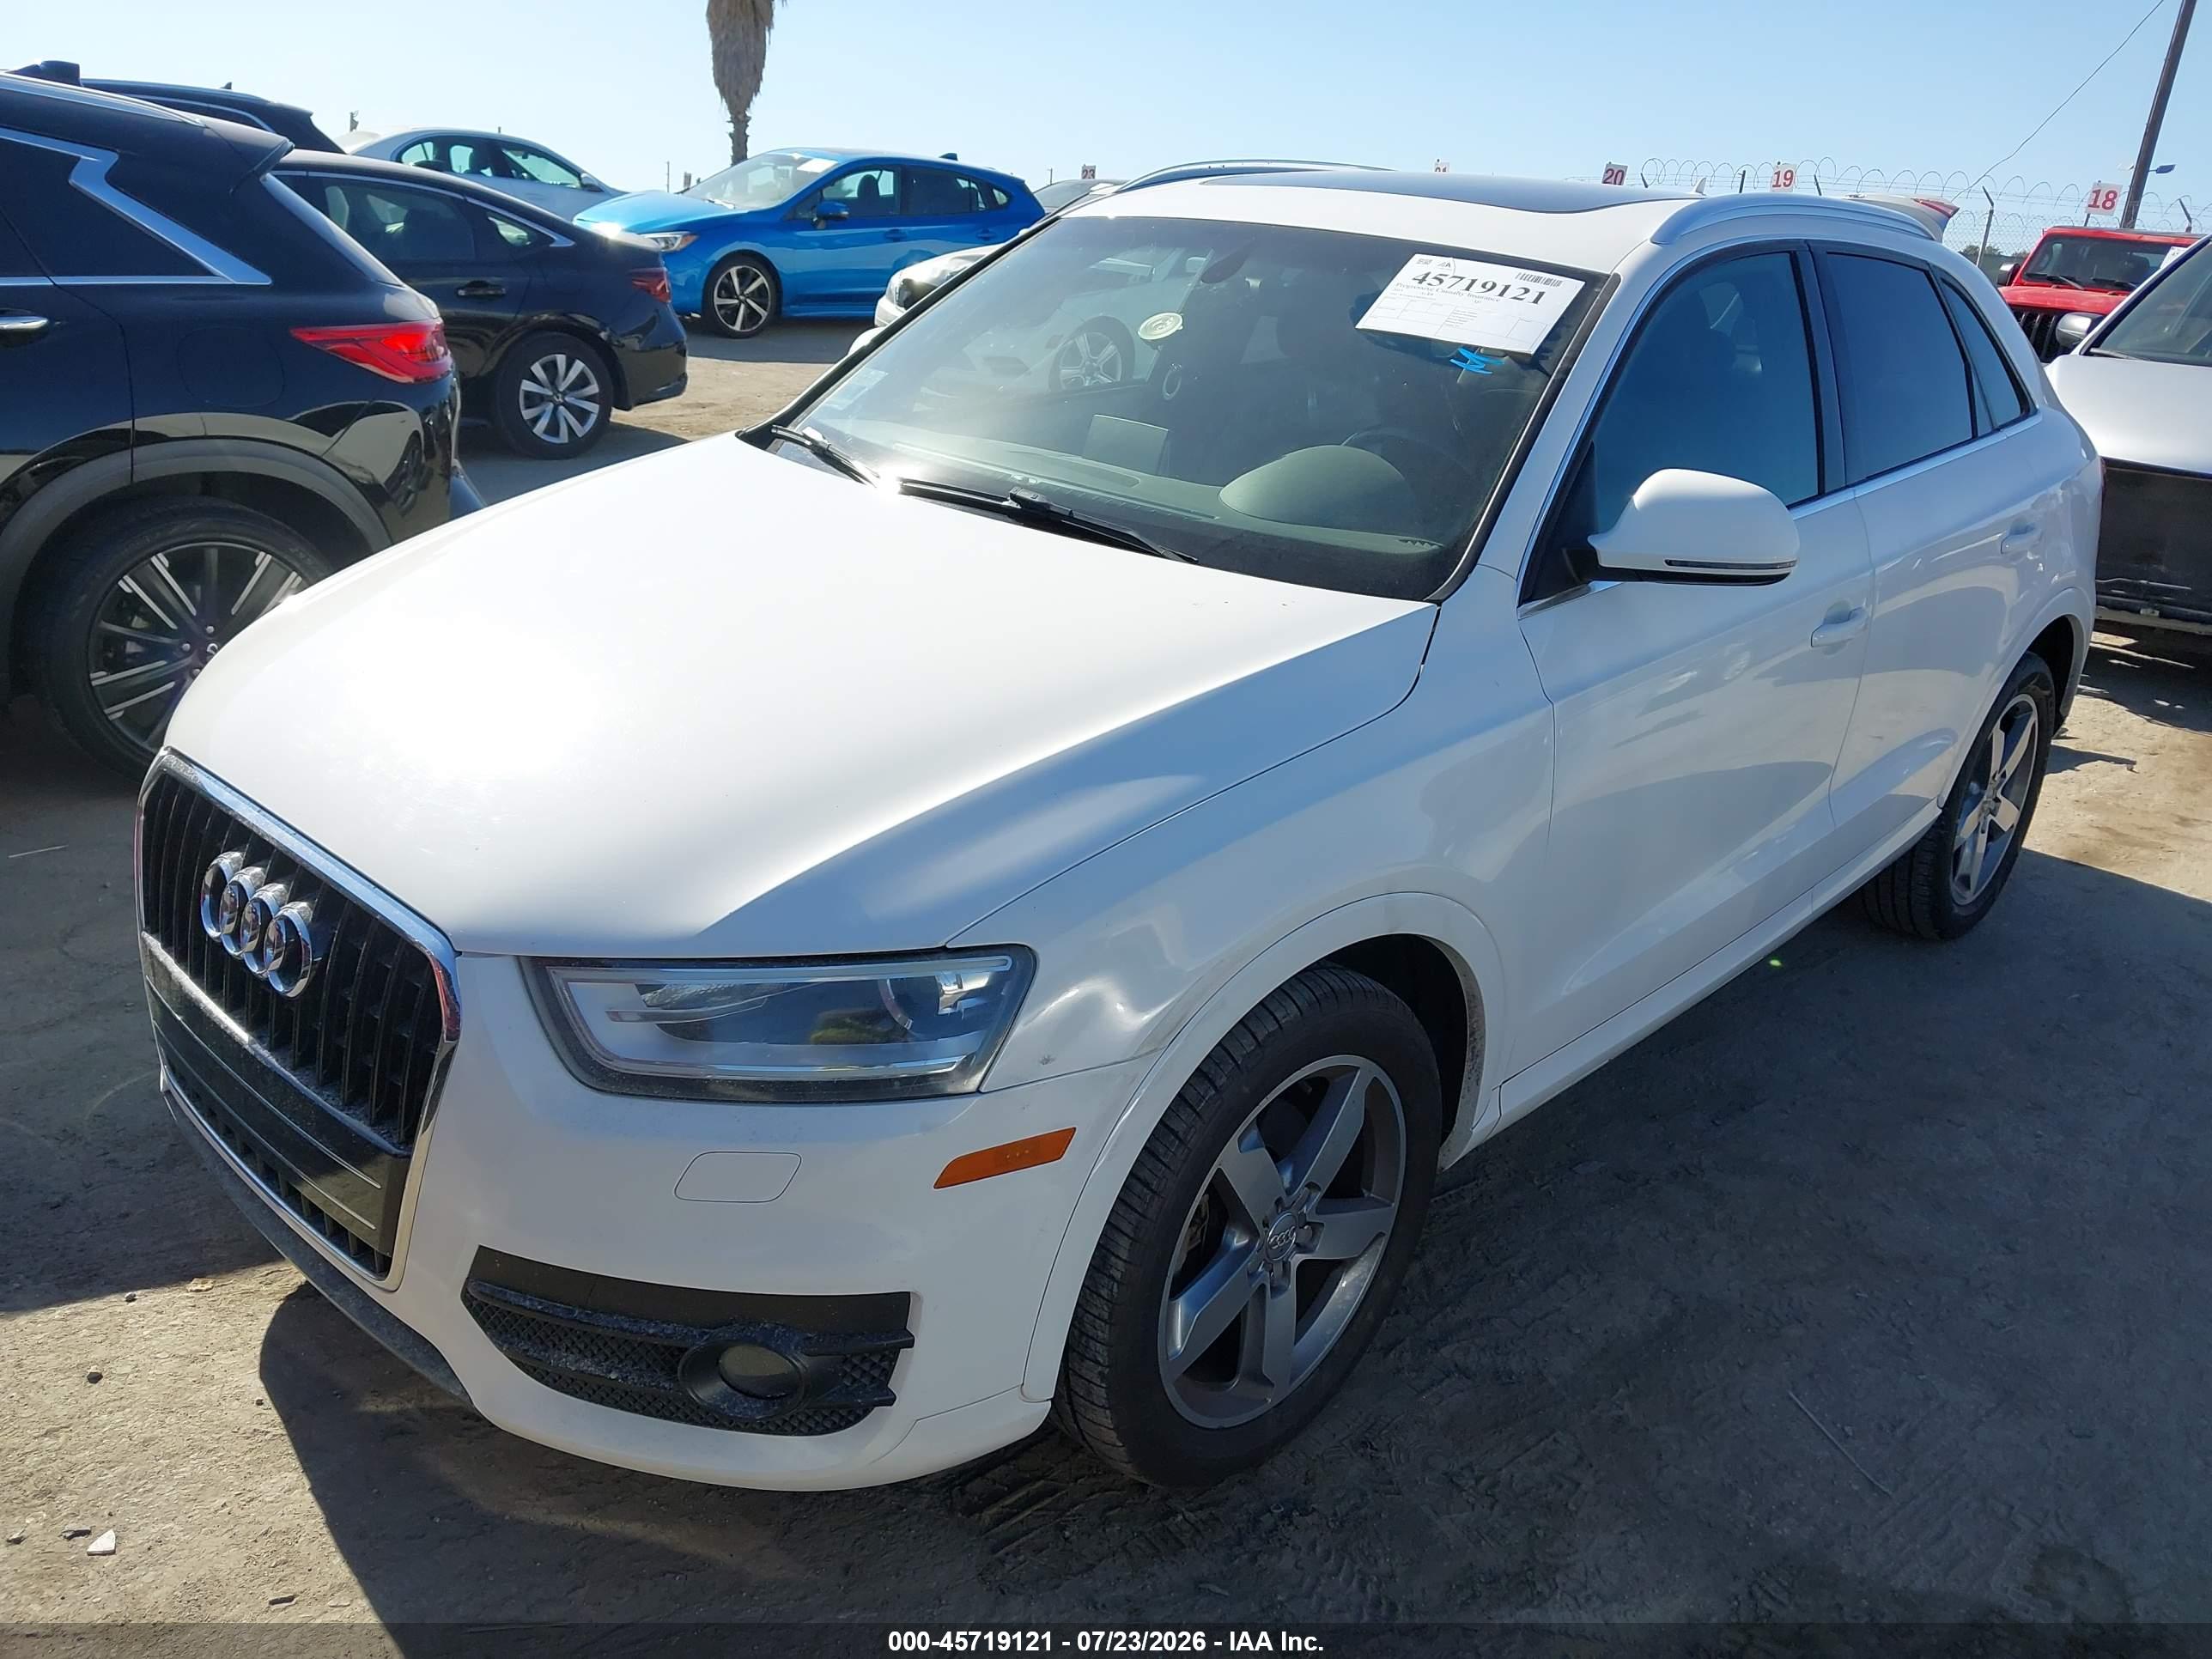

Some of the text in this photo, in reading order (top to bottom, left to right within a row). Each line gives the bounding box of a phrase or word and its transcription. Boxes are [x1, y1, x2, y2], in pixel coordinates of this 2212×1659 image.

[1603, 167, 1624, 185] 20
[1771, 169, 1794, 188] 19
[2087, 189, 2118, 210] 18
[1412, 271, 1547, 305] 45719121
